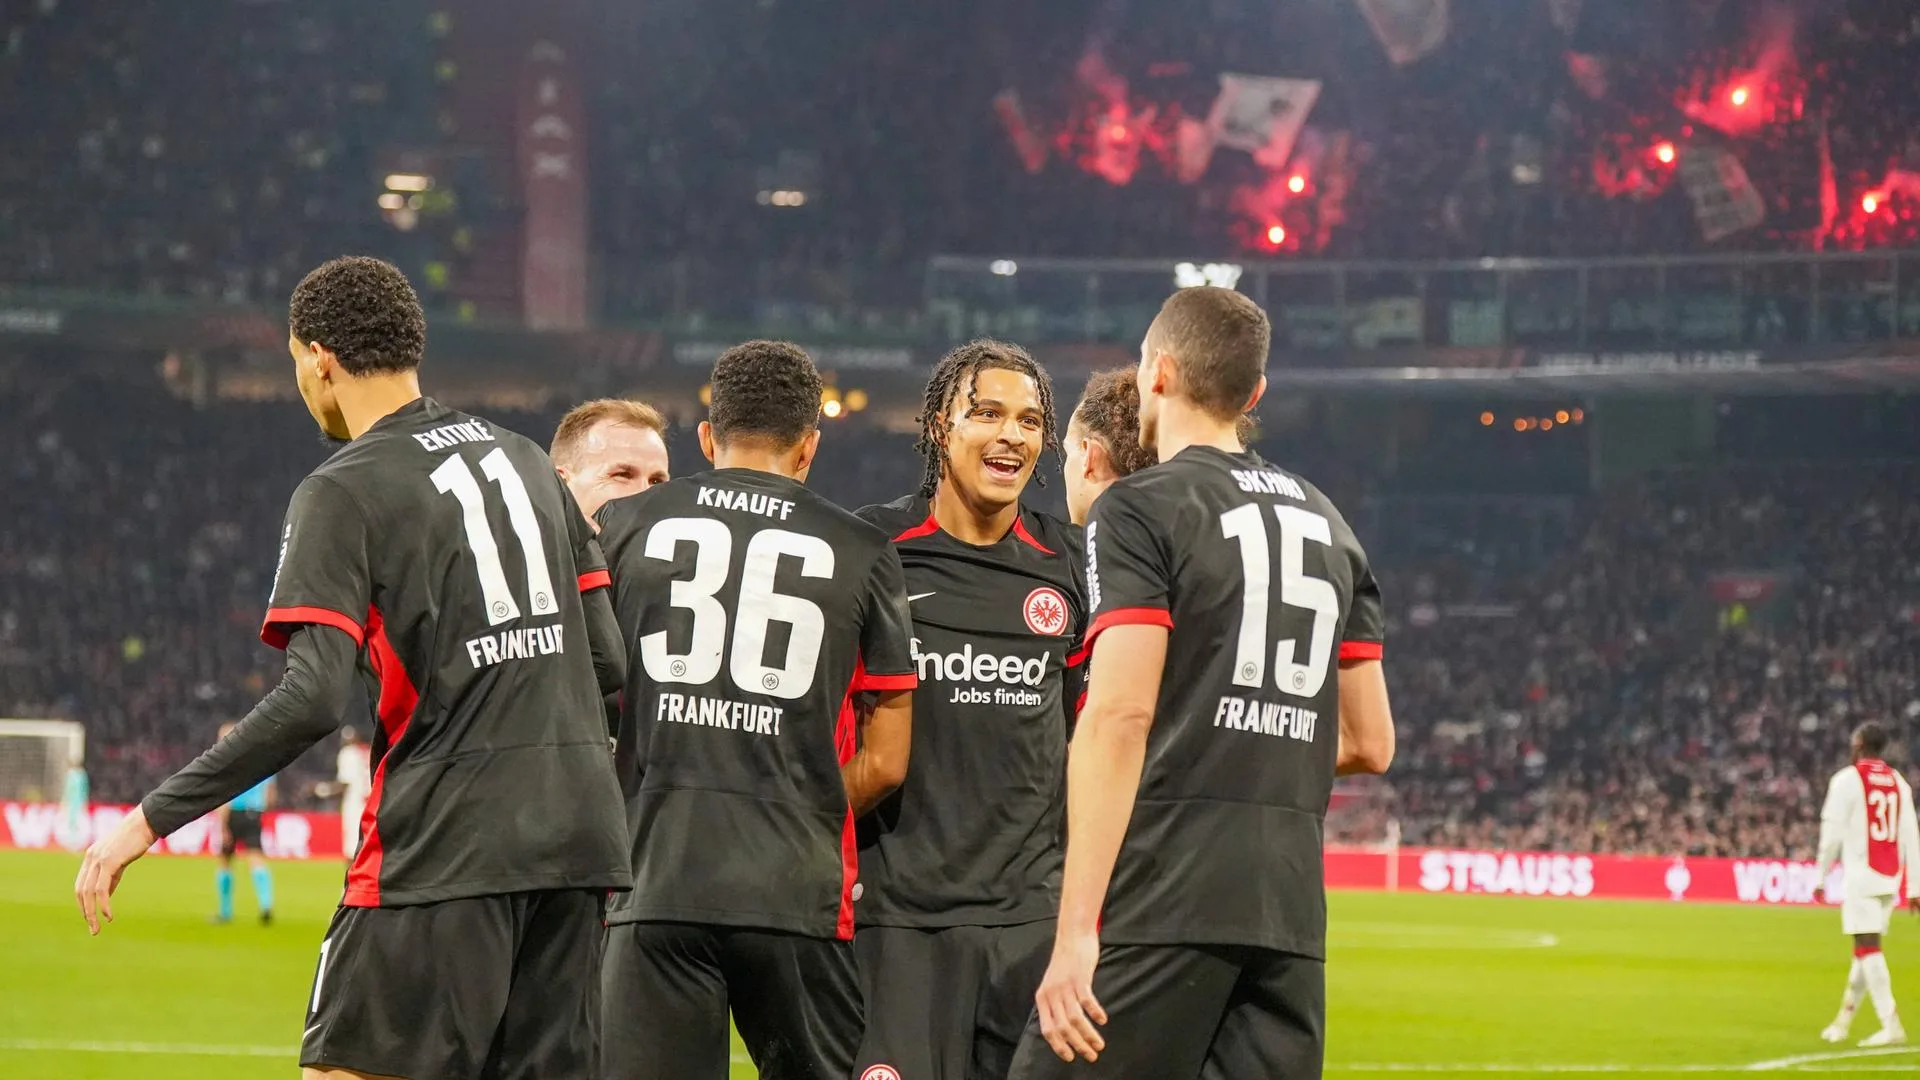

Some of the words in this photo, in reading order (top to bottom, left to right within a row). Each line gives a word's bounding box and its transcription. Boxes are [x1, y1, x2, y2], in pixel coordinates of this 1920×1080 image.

[411, 418, 496, 452] EKITIKÉ
[697, 486, 796, 521] KNAUFF
[429, 447, 560, 627] 11
[640, 517, 835, 699] 36
[1220, 502, 1340, 698] 15
[465, 624, 564, 669] FRANKFUR
[657, 693, 783, 736] FRANKFURT
[950, 687, 991, 704] Jobs
[994, 688, 1041, 706] finden
[1213, 696, 1318, 743] FRANKFURT
[1868, 789, 1898, 843] 31
[1419, 851, 1595, 897] STRAUSS
